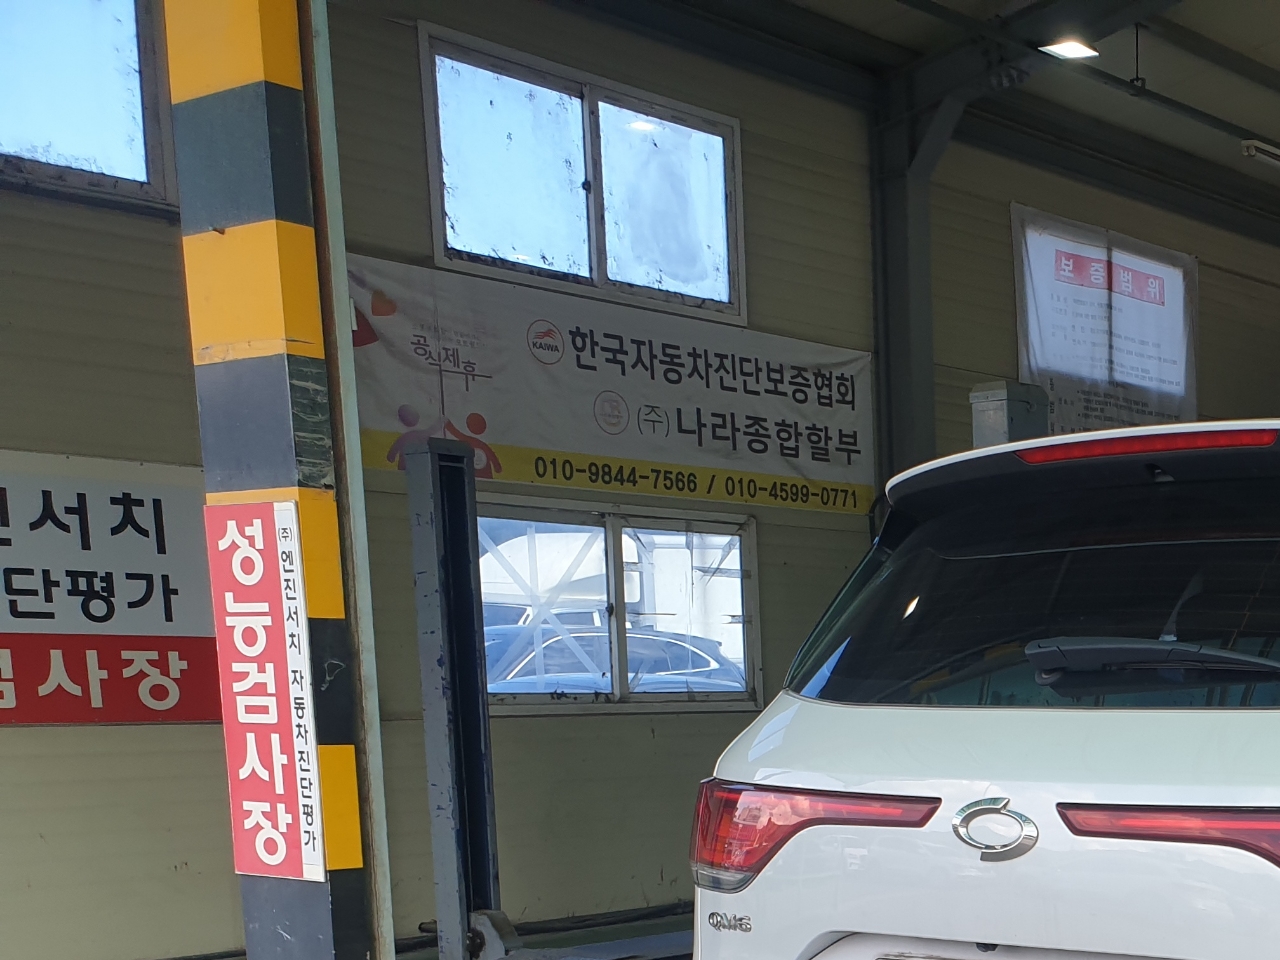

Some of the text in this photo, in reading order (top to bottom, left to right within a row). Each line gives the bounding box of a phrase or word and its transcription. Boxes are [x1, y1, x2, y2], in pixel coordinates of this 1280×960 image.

[532, 341, 560, 353] KAIWA
[569, 326, 857, 411] 한국자동차진단보증협회
[534, 457, 698, 494] 010-9844-7566
[725, 476, 858, 509] 010-4599-0771
[0, 486, 168, 555] 서치
[3, 567, 180, 623] 단평가
[0, 647, 188, 711] 사장
[217, 518, 293, 866] 성능검사장
[290, 669, 317, 852] 자동차진단평가
[708, 911, 752, 933] QM6
